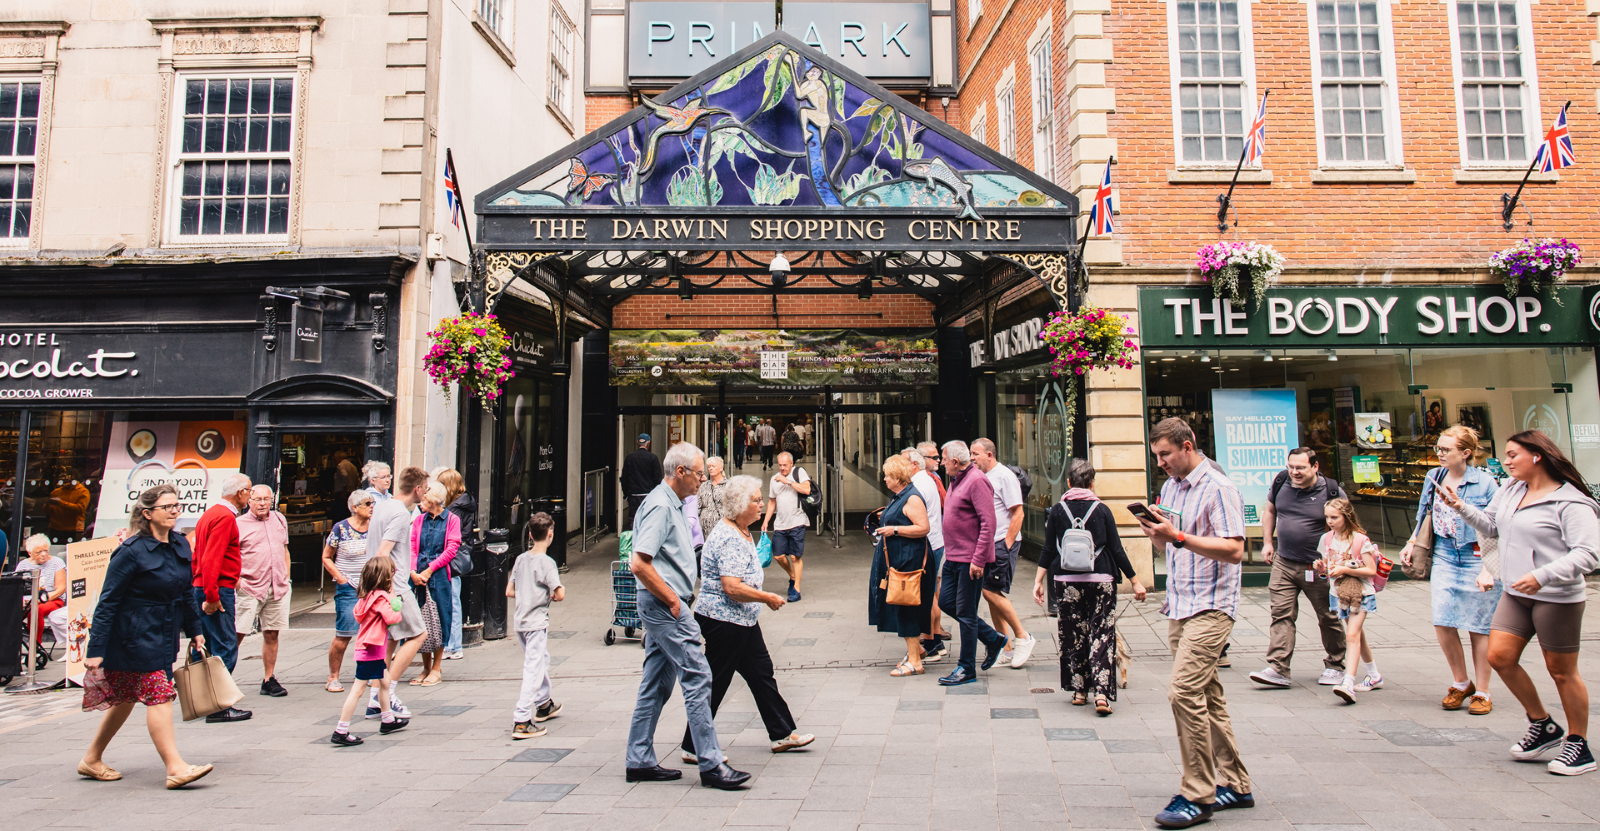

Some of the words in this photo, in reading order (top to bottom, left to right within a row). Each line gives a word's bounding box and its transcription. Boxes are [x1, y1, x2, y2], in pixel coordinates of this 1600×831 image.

[530, 218, 587, 240] THE
[611, 218, 729, 241] DARWIN
[750, 218, 886, 242] SHOPPING
[908, 218, 1022, 241] CENTRE
[1163, 298, 1249, 336] THE
[1268, 297, 1399, 336] BODY
[969, 340, 985, 368] THE
[44, 388, 93, 398] GROWER
[1046, 413, 1058, 427] THE
[1534, 419, 1548, 427] THE
[1043, 430, 1063, 446] BODY
[1225, 423, 1287, 444] RADIANT
[1573, 425, 1599, 436] REFILL
[1045, 450, 1062, 465] SHOP
[1231, 448, 1286, 467] SUMMER
[176, 478, 203, 487] YOUR
